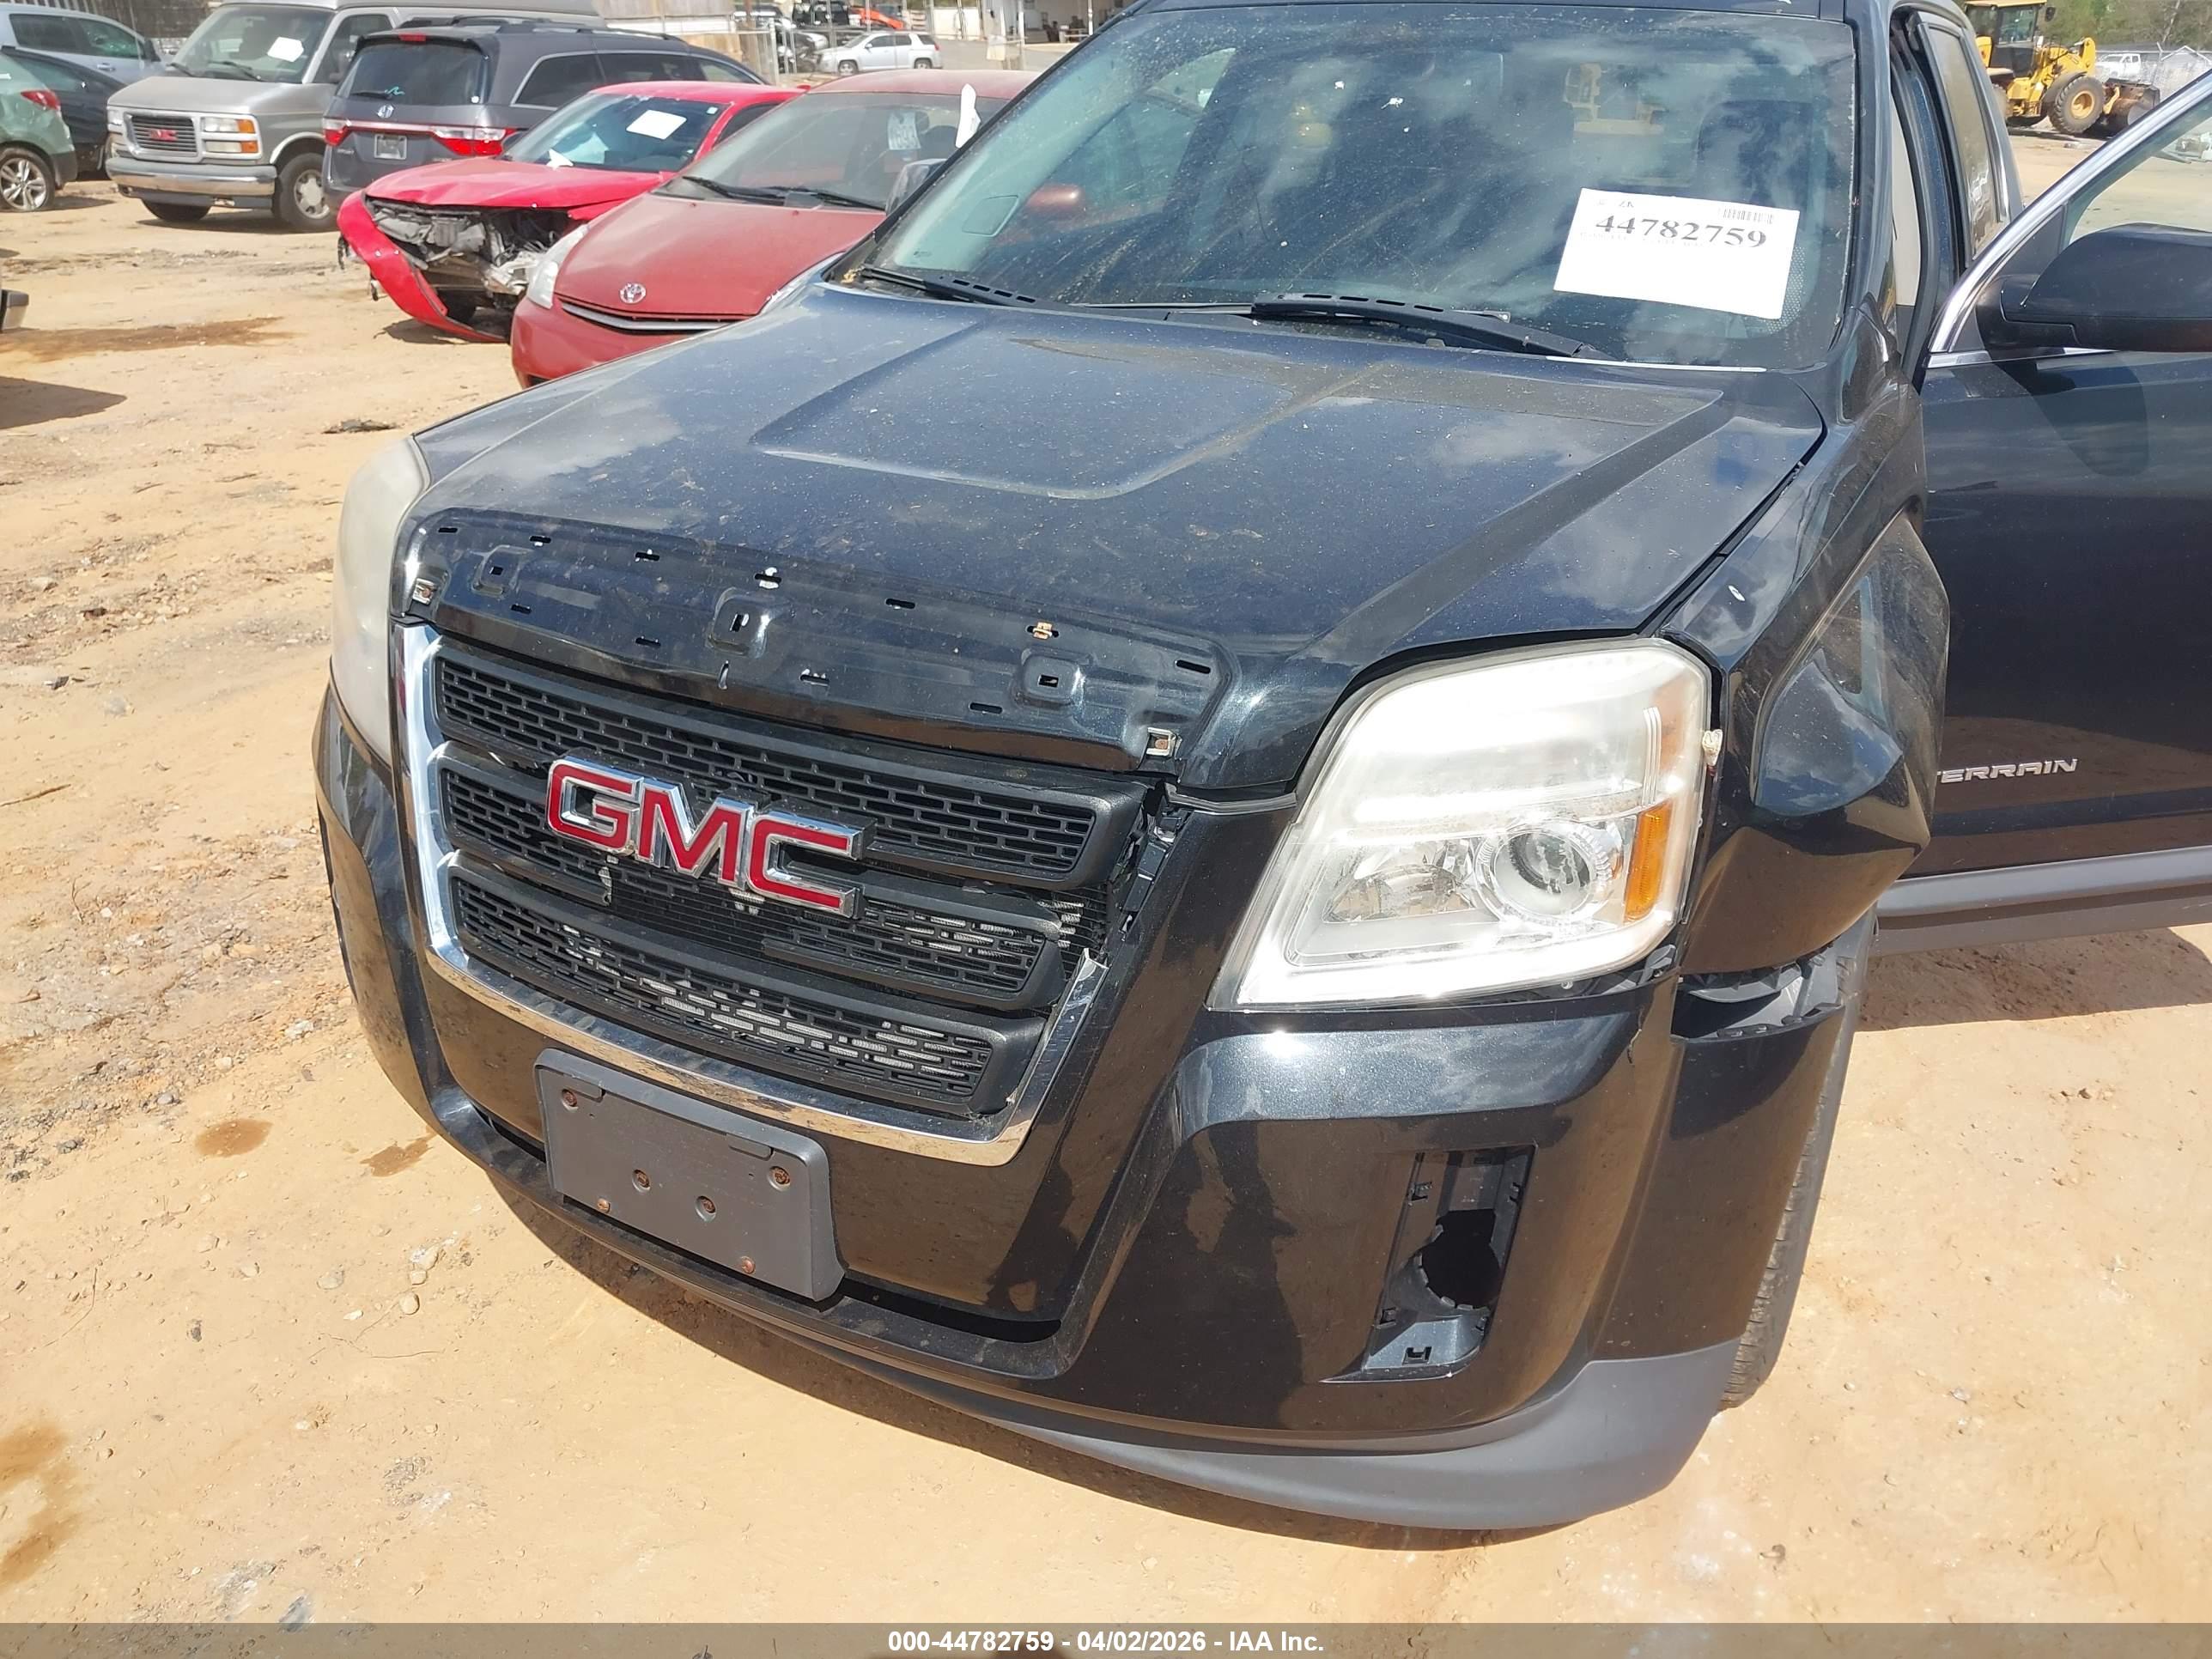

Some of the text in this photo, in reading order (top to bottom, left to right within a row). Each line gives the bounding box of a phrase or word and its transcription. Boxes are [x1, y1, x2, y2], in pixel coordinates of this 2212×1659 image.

[1595, 215, 1767, 248] 44782759
[1937, 757, 2079, 784] ERRAIN
[545, 755, 861, 919] GMC
